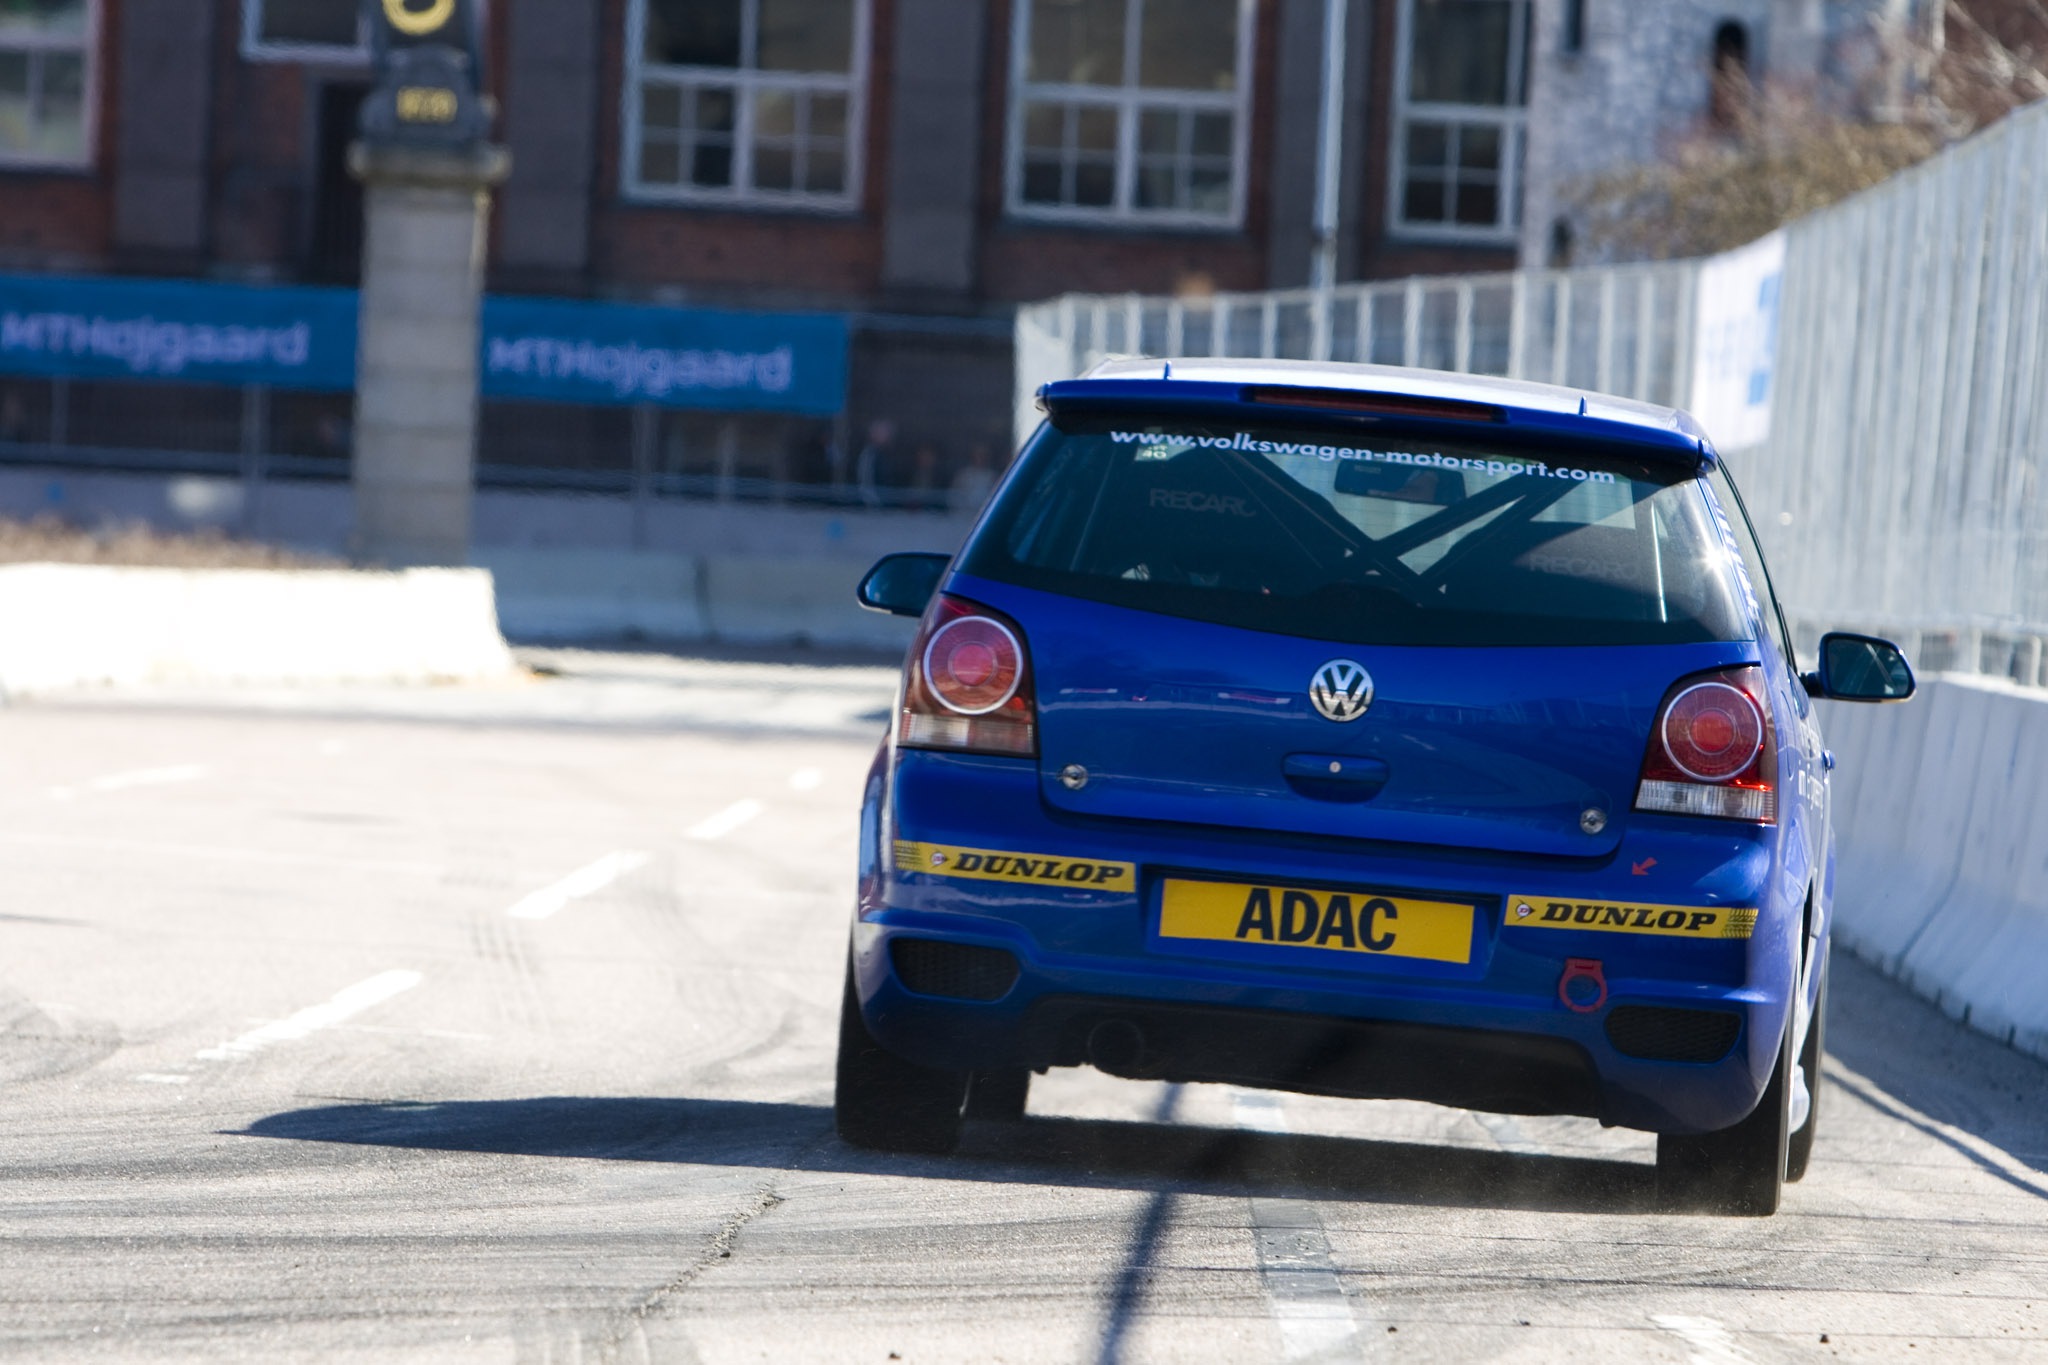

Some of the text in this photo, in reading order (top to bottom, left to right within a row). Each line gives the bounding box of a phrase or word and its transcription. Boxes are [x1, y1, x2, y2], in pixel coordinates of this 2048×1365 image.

[1110, 430, 1616, 485] www.volkswagen-motorsport.com
[954, 852, 1125, 884] DUNLOP
[1234, 887, 1399, 952] ADAC
[1540, 902, 1717, 931] DUNLOP
